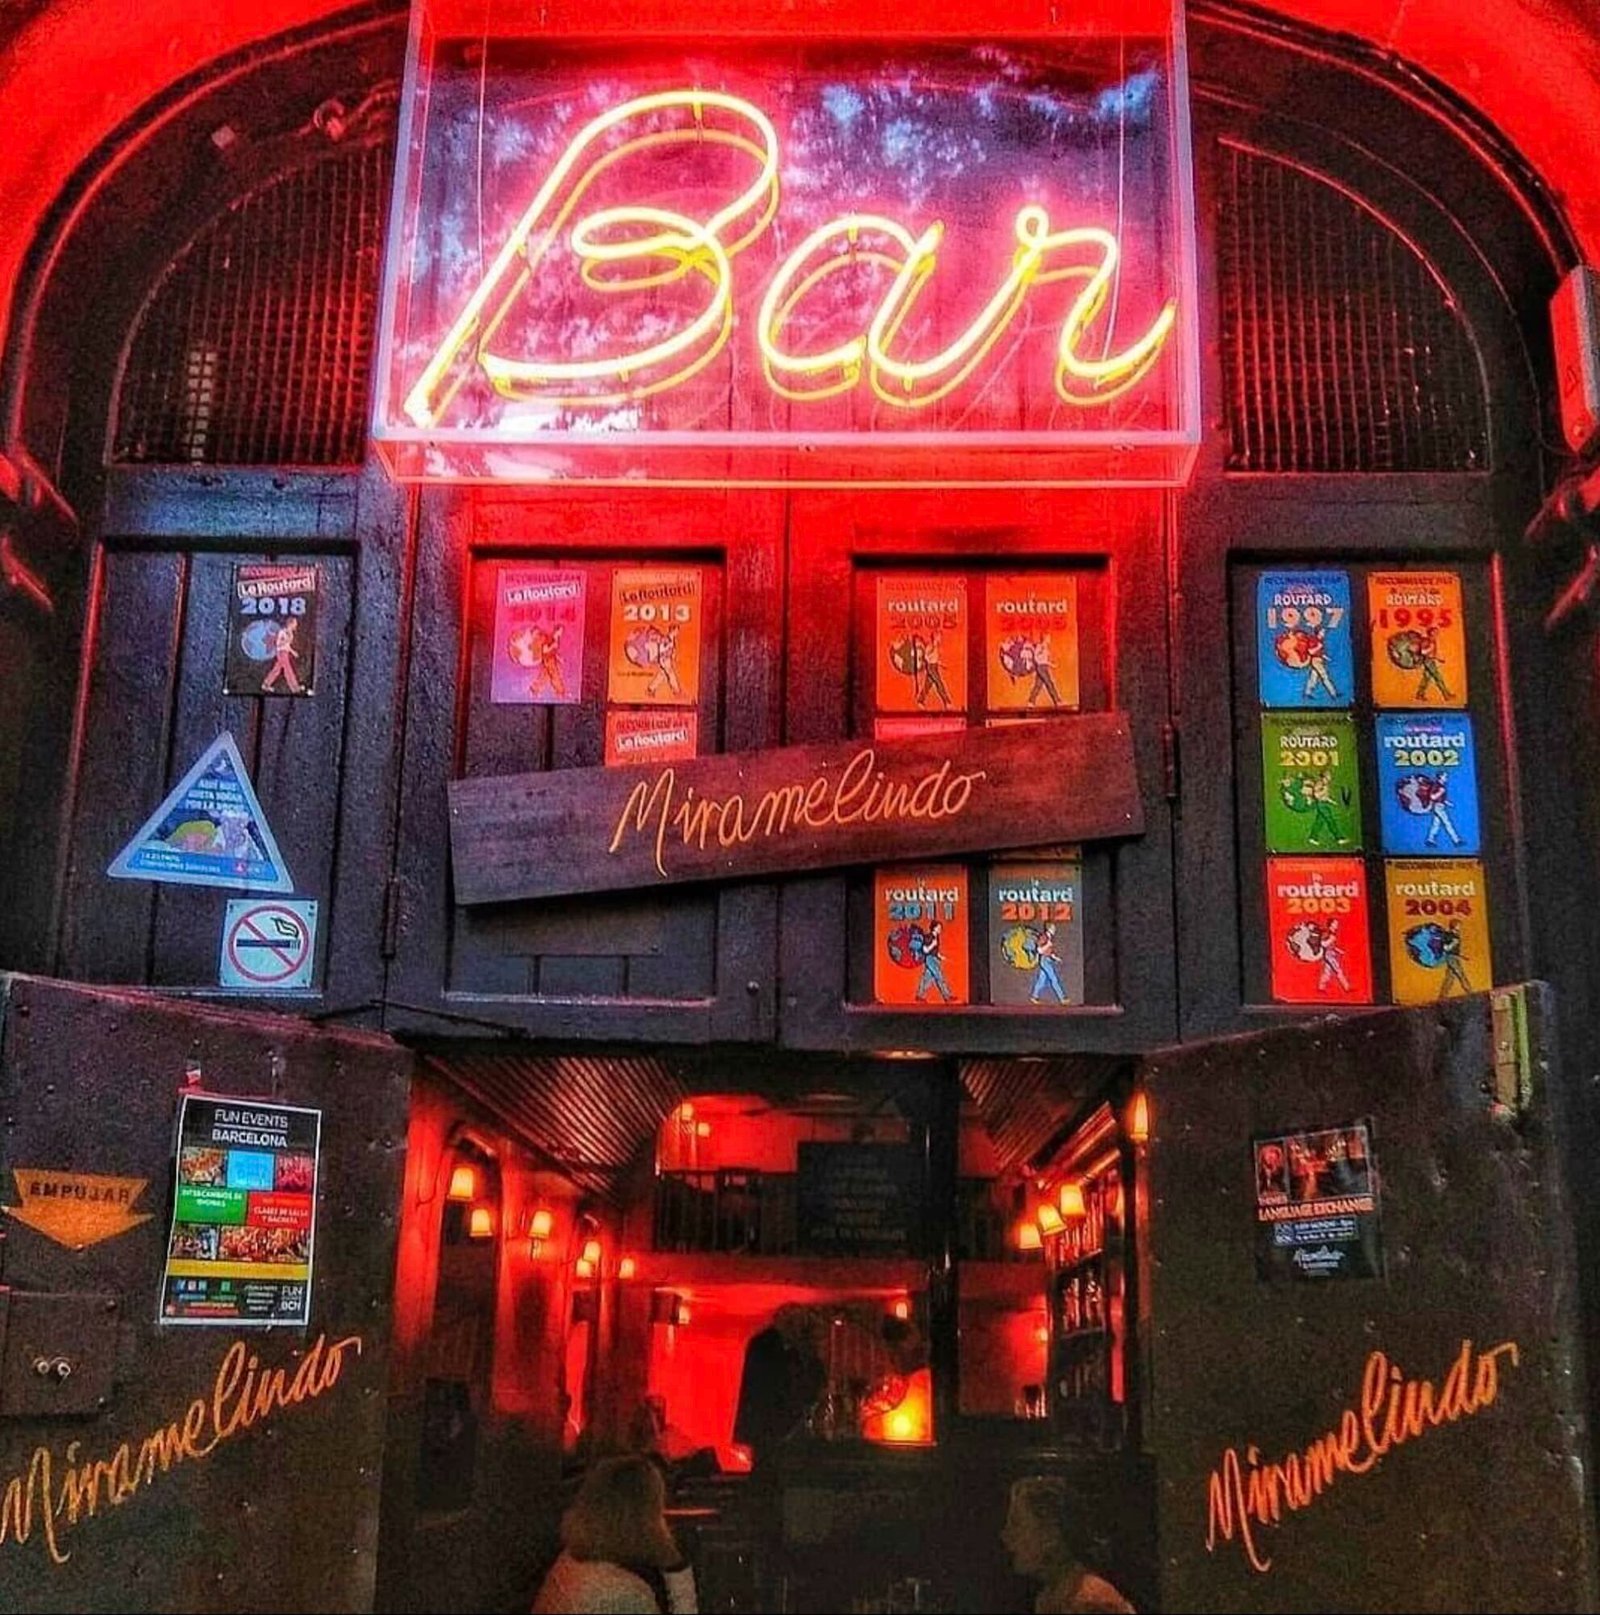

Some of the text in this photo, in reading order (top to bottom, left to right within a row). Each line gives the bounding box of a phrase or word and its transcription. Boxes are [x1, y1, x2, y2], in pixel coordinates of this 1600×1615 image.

[404, 89, 1178, 428] Bar
[240, 597, 306, 615] 2018
[888, 598, 959, 613] routard
[996, 598, 1068, 614] routard
[1274, 593, 1332, 606] ROUTARD
[1386, 593, 1443, 606] ROUTARD
[623, 604, 691, 622] 2013
[1267, 607, 1344, 629] 1997
[1379, 608, 1452, 629] 1995
[1280, 735, 1338, 748] ROUTARD
[1384, 732, 1466, 748] routard
[1279, 751, 1339, 767] 2001
[1394, 750, 1460, 767] 2002
[608, 748, 988, 878] Miramelindo
[884, 887, 959, 902] routard
[998, 887, 1074, 903] routard
[1277, 881, 1359, 898] routard
[1396, 881, 1476, 897] routard
[889, 902, 955, 921] 2011
[1002, 902, 1072, 921] 2012
[1405, 899, 1472, 916] 2004
[214, 1109, 288, 1128] FUN EVENTS
[212, 1129, 288, 1148] BARCELONA
[29, 1181, 131, 1203] EMPUJAR
[0, 1333, 362, 1565] Miramelindo
[1205, 1338, 1520, 1573] Miramelindo
